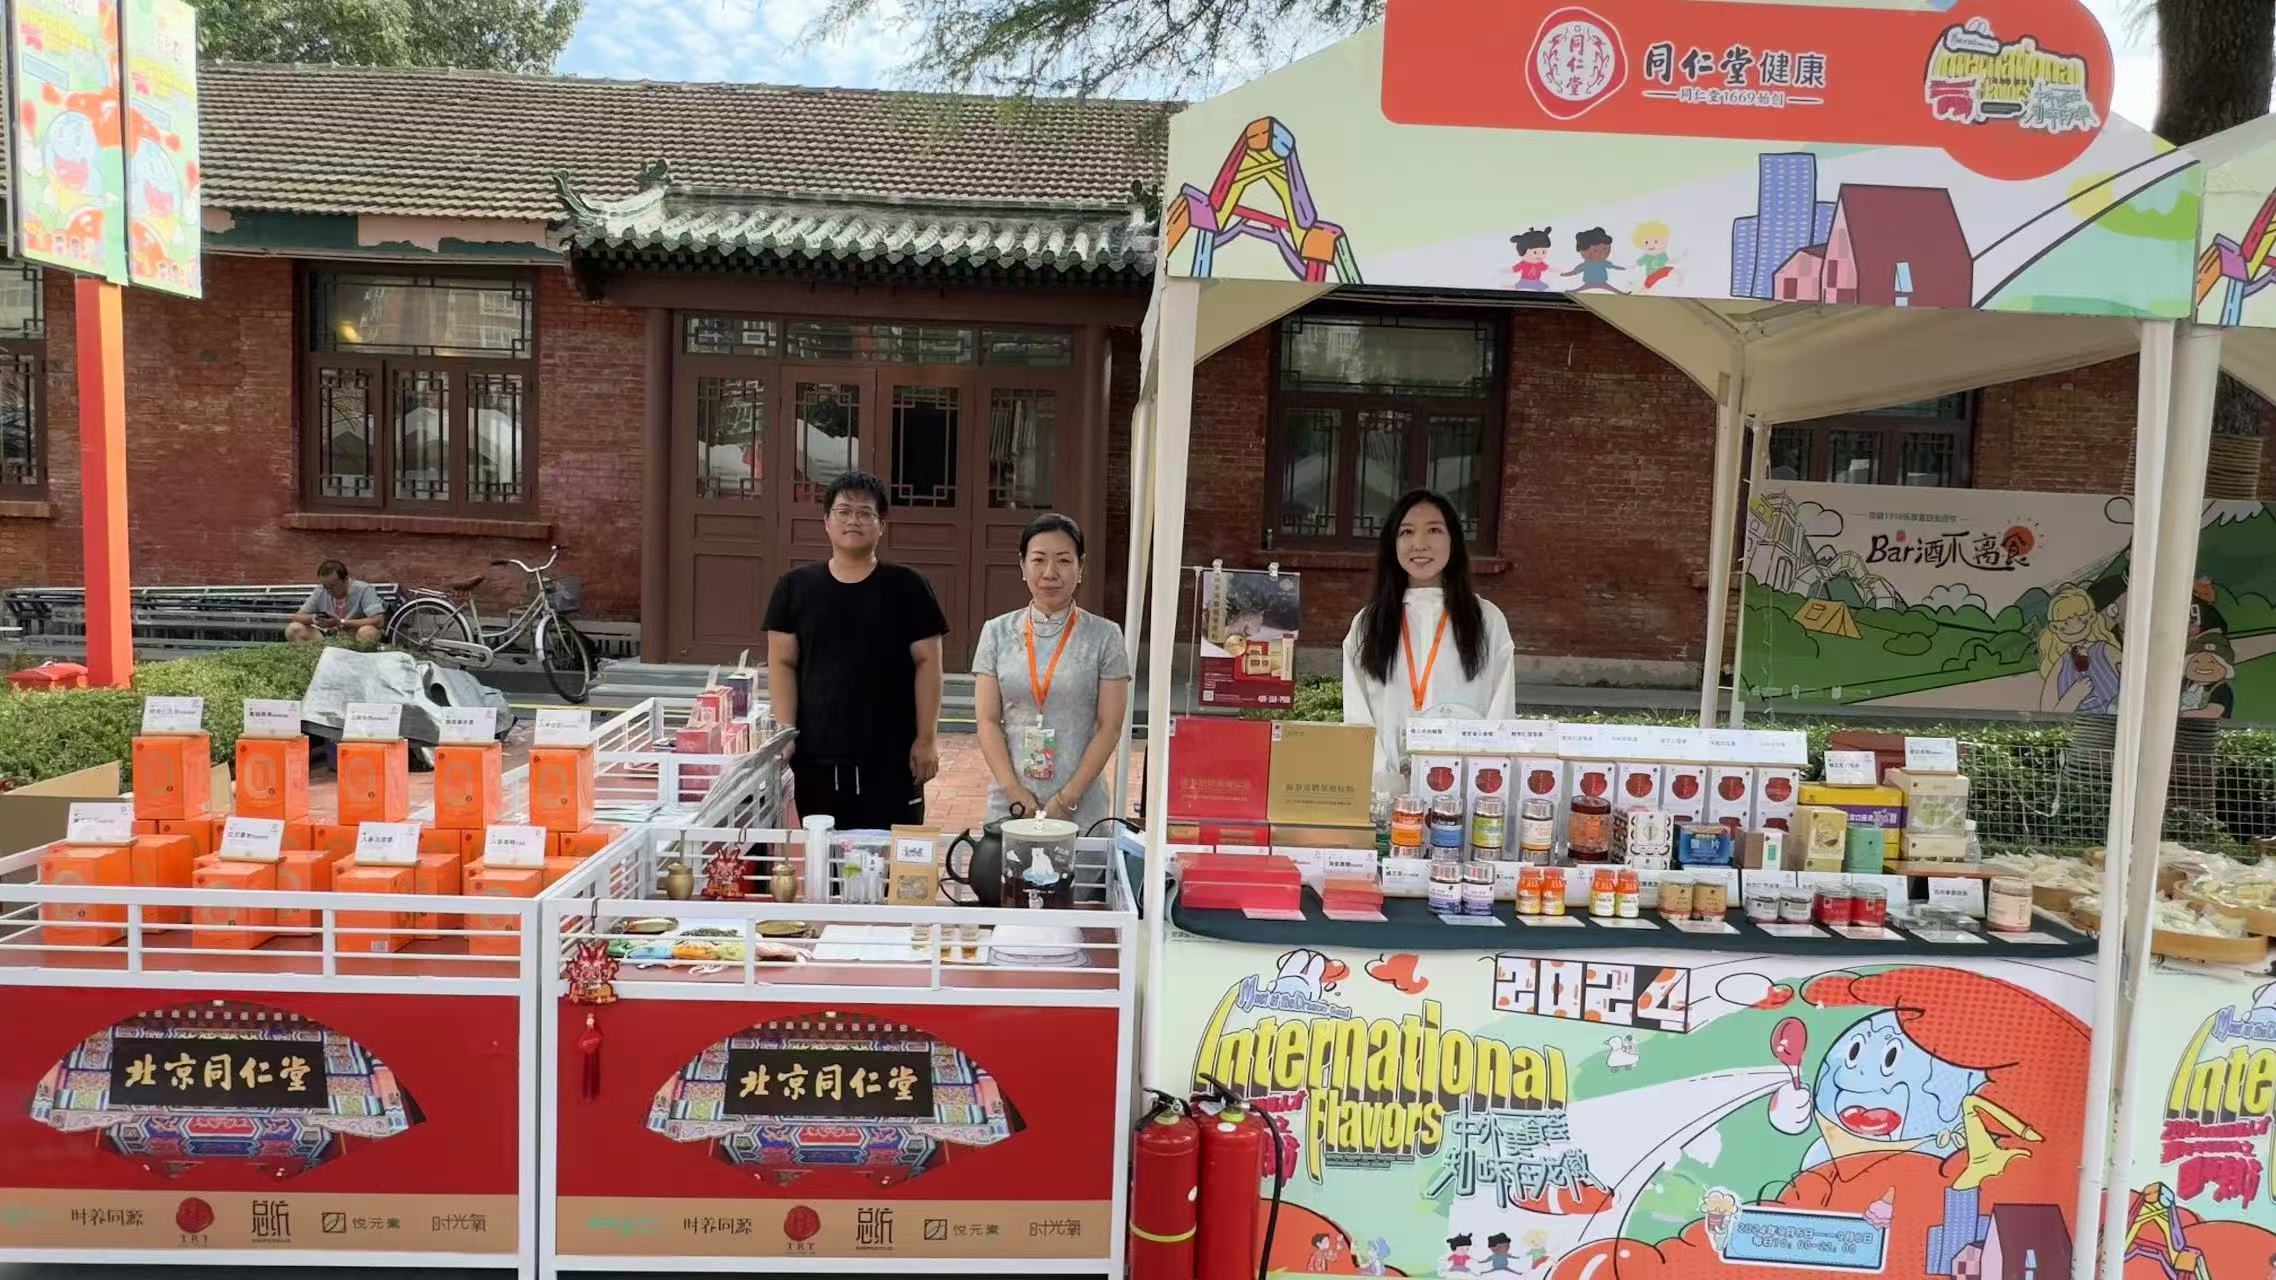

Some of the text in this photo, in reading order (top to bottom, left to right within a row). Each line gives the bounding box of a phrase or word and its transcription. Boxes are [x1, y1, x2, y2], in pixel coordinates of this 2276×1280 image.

[1566, 33, 1585, 97] 同仁堂
[1645, 42, 1826, 87] 同仁堂健康
[1495, 957, 1689, 1033] 2024
[125, 1052, 311, 1091] 北京同仁堂
[1193, 981, 1568, 1110] International
[739, 1063, 918, 1100] 北京同仁堂
[1308, 1089, 1443, 1183] Flavors
[683, 1217, 752, 1235] 时养同源
